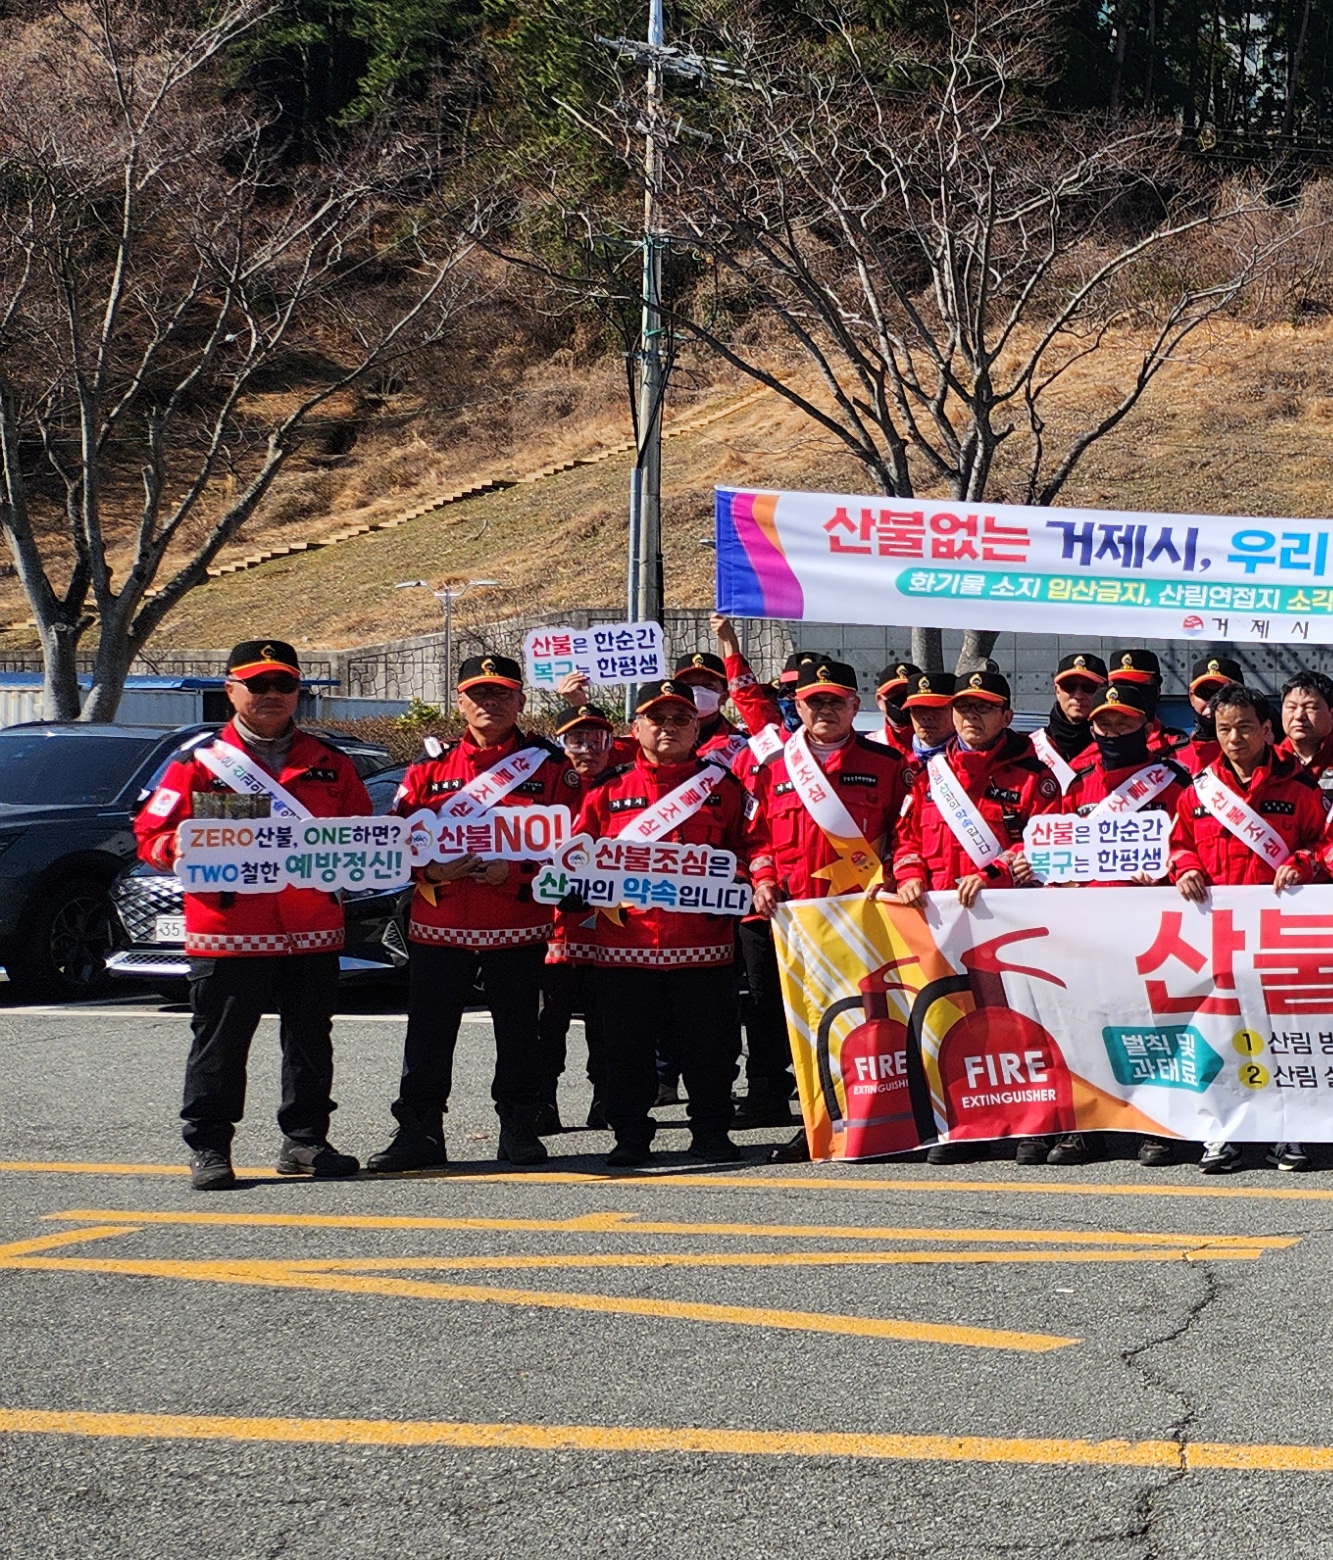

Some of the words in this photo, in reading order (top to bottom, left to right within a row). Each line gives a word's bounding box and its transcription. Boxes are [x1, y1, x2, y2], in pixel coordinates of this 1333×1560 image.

[822, 506, 1032, 563] 산불없는
[1045, 519, 1213, 573] 거제시,
[1226, 528, 1328, 577] 우리
[909, 570, 982, 597] 화기물
[990, 573, 1041, 599] 소지
[1047, 577, 1151, 605] 입산금지,
[1158, 582, 1280, 612] 산림연접지
[531, 633, 589, 659] 산불은
[593, 627, 657, 653] 한순간
[596, 653, 659, 680] 한평생
[639, 776, 717, 837] 산불조심
[1107, 769, 1167, 812] 산불조
[190, 825, 299, 850] ZERO산불,
[303, 824, 402, 846] ONE하면?
[437, 813, 563, 855] 산불NO!
[1030, 821, 1091, 847] 산불은
[1096, 817, 1164, 844] 한순간
[1210, 790, 1284, 859] 산불조심
[186, 861, 280, 885] TWO철한
[285, 850, 403, 883] 예방정신!
[594, 843, 731, 879] 산불조심은
[1030, 851, 1090, 875] 복구는
[1096, 846, 1163, 873] 한평생
[538, 871, 615, 903] 산과의
[622, 877, 748, 911] 약속입니다
[1120, 1033, 1172, 1056] 벌칙
[1175, 1032, 1196, 1060] 및
[1267, 1030, 1312, 1055] 산림
[853, 1050, 908, 1082] FIRE
[963, 1050, 1049, 1089] FIRE
[1128, 1057, 1199, 1087] 과태료
[1273, 1065, 1317, 1090] 산림
[853, 1078, 909, 1096] EXTINGUISH
[961, 1088, 1057, 1109] EXTINGUISHER
